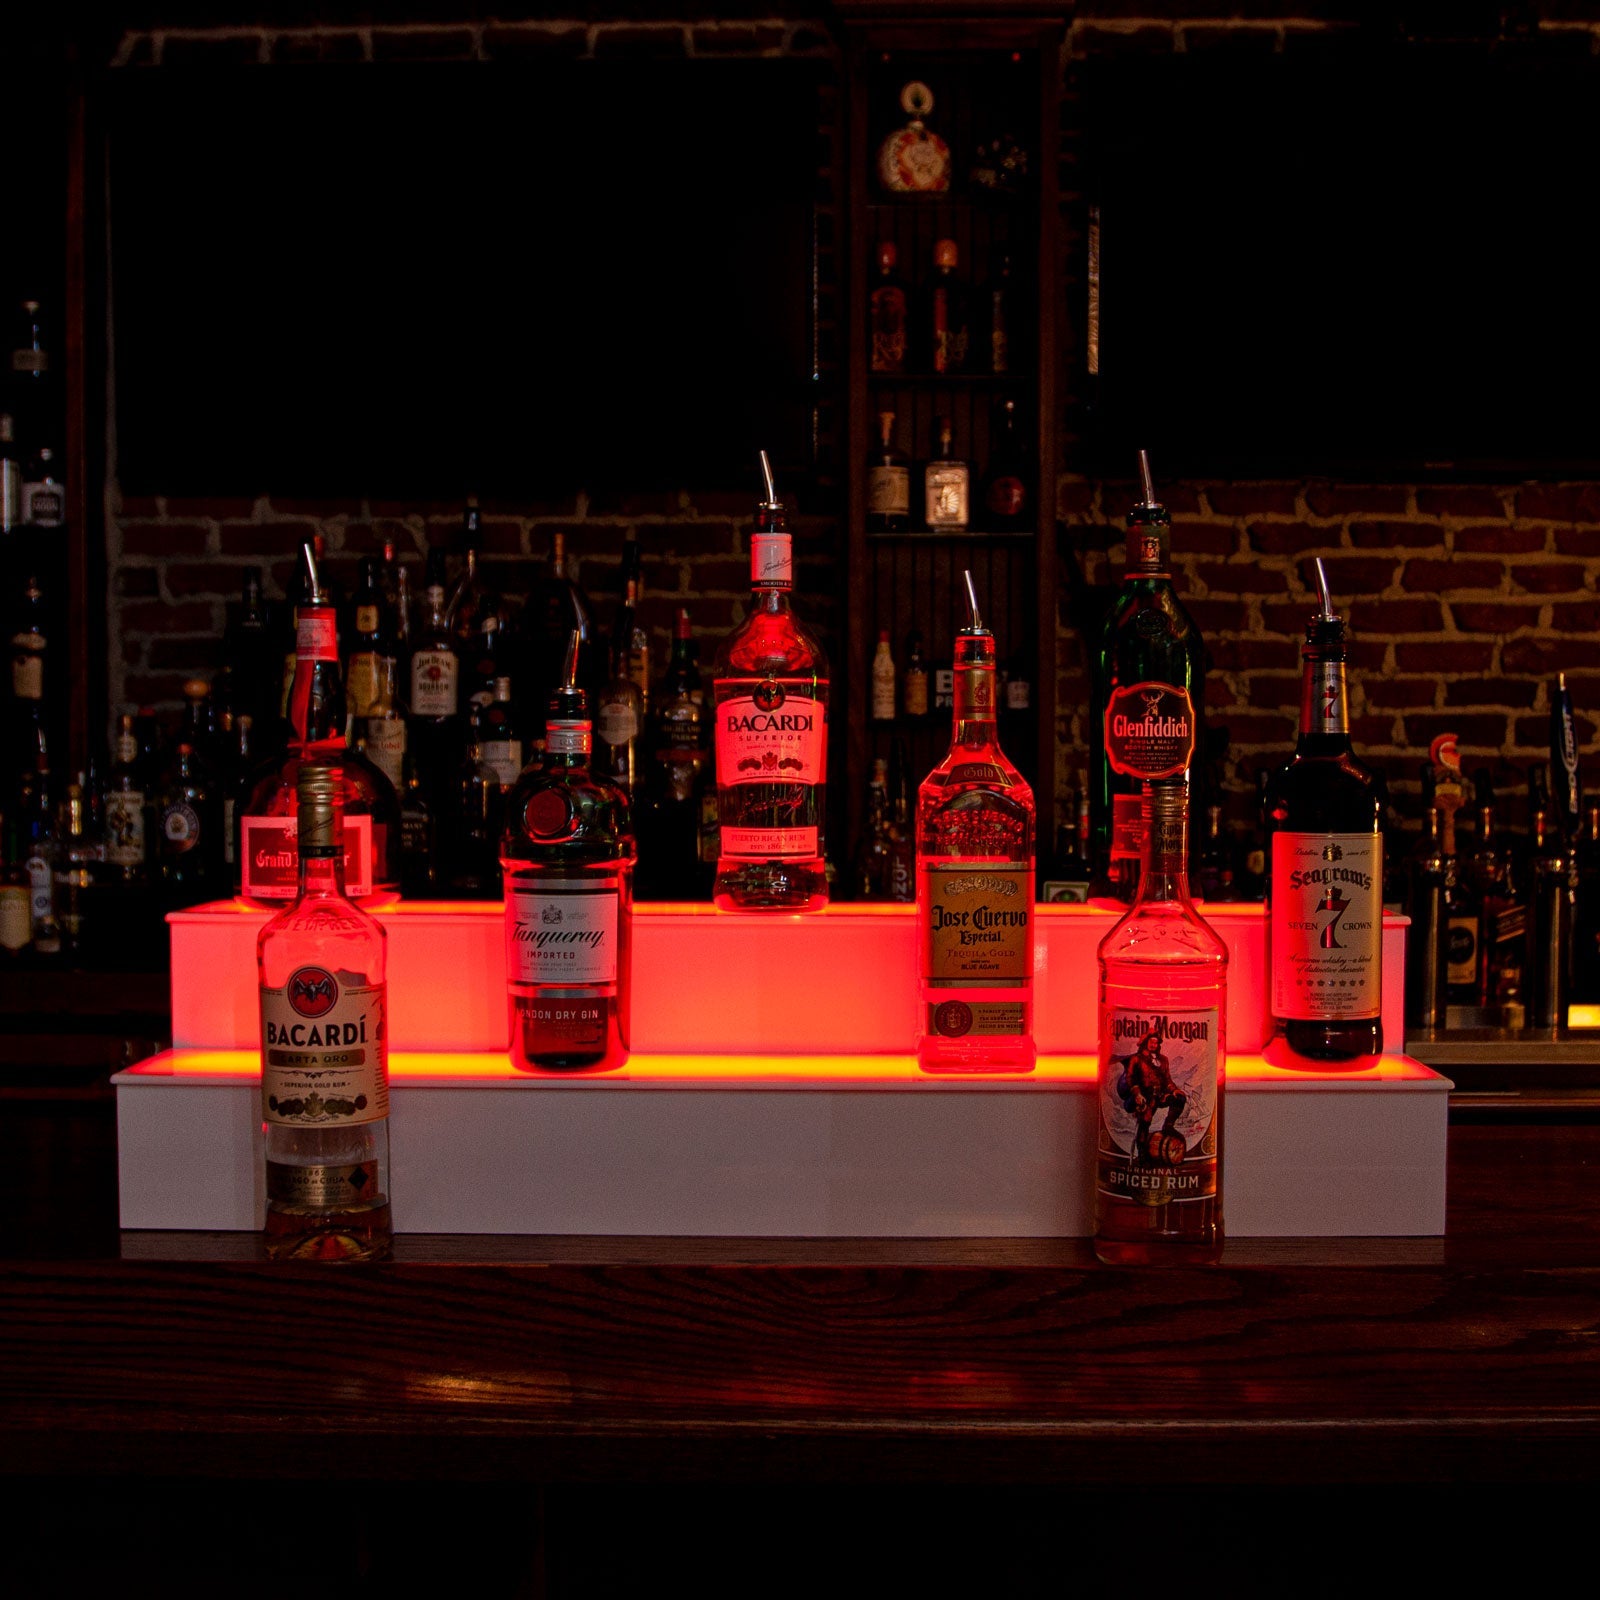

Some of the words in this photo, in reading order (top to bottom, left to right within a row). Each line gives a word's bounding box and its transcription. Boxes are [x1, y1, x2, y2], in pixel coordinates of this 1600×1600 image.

[727, 714, 813, 732] BACARDI
[1113, 714, 1188, 737] Glenfiddich
[963, 766, 994, 778] Gold
[731, 834, 761, 842] PUERTO
[761, 834, 787, 842] RICAN
[255, 849, 292, 868] Grand
[1290, 867, 1373, 890] Seagram's
[931, 905, 970, 931] Jose
[972, 905, 1028, 931] Cuervo
[1287, 921, 1318, 930] SEVEN
[1315, 898, 1351, 949] 7
[1342, 921, 1372, 930] CROWN
[511, 920, 605, 949] Tanqueray
[960, 930, 1001, 946] Especial
[526, 951, 576, 960] IMPORTED
[988, 948, 1016, 957] GOLD
[516, 1008, 551, 1019] LONDON
[555, 1010, 577, 1019] DRY
[581, 1009, 599, 1019] GIN
[267, 1014, 366, 1047] BACARDÍ
[1150, 1015, 1208, 1043] Morgan
[279, 1055, 318, 1065] CARTA
[323, 1054, 349, 1064] ORO
[284, 1081, 313, 1090] SUPERIOR
[314, 1081, 331, 1089] GOLD
[333, 1081, 346, 1089] RUM
[1126, 1166, 1179, 1176] ORIGINAL
[1109, 1171, 1160, 1190] SPICED
[1166, 1175, 1199, 1189] RUM
